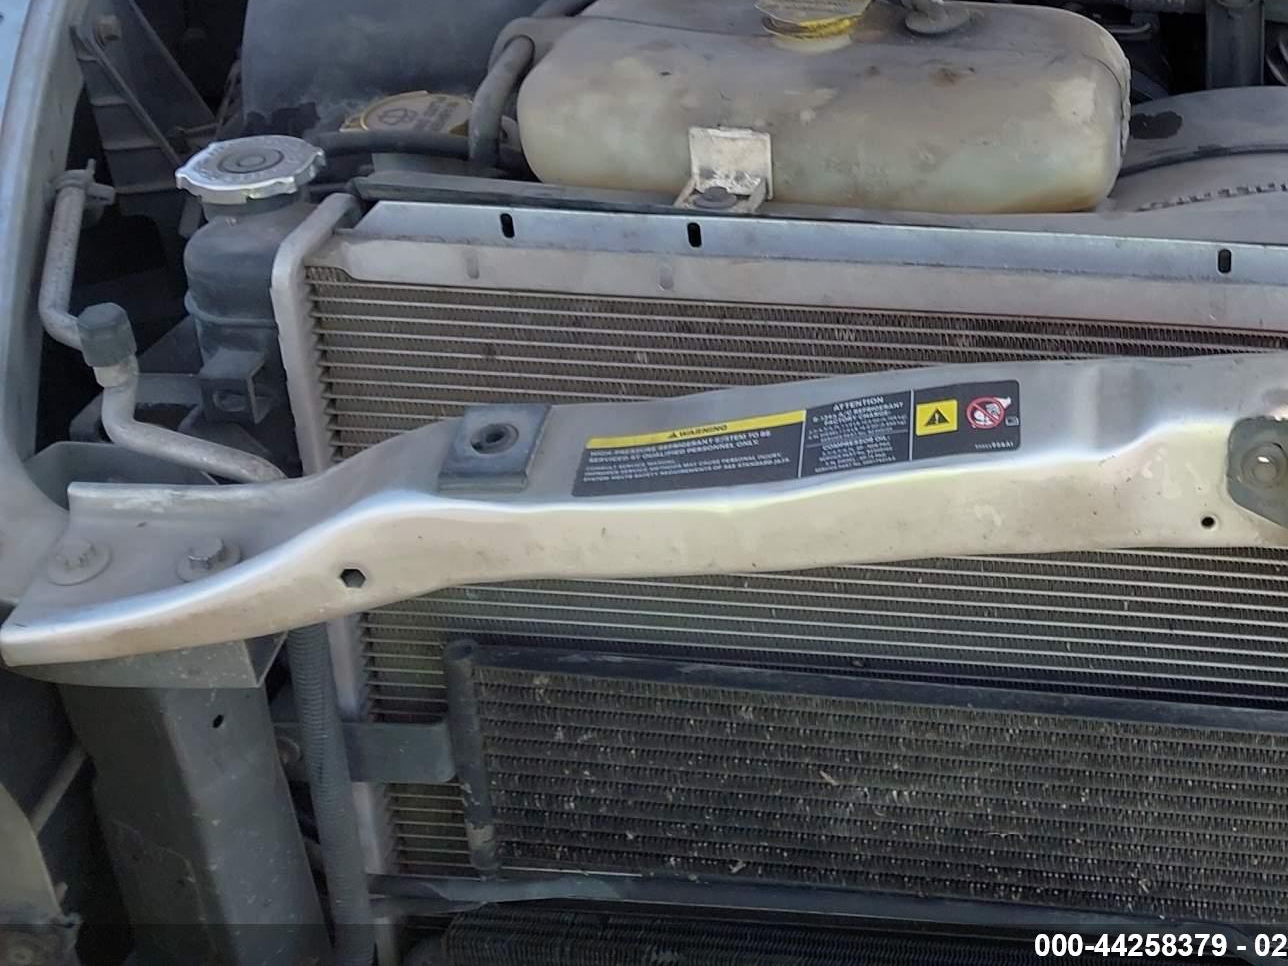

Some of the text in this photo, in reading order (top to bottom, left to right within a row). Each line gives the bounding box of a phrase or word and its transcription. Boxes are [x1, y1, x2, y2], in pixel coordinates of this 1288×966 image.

[833, 397, 884, 412] ATTENTION
[679, 424, 727, 436] WARNING
[687, 442, 734, 452] PERSONNEL
